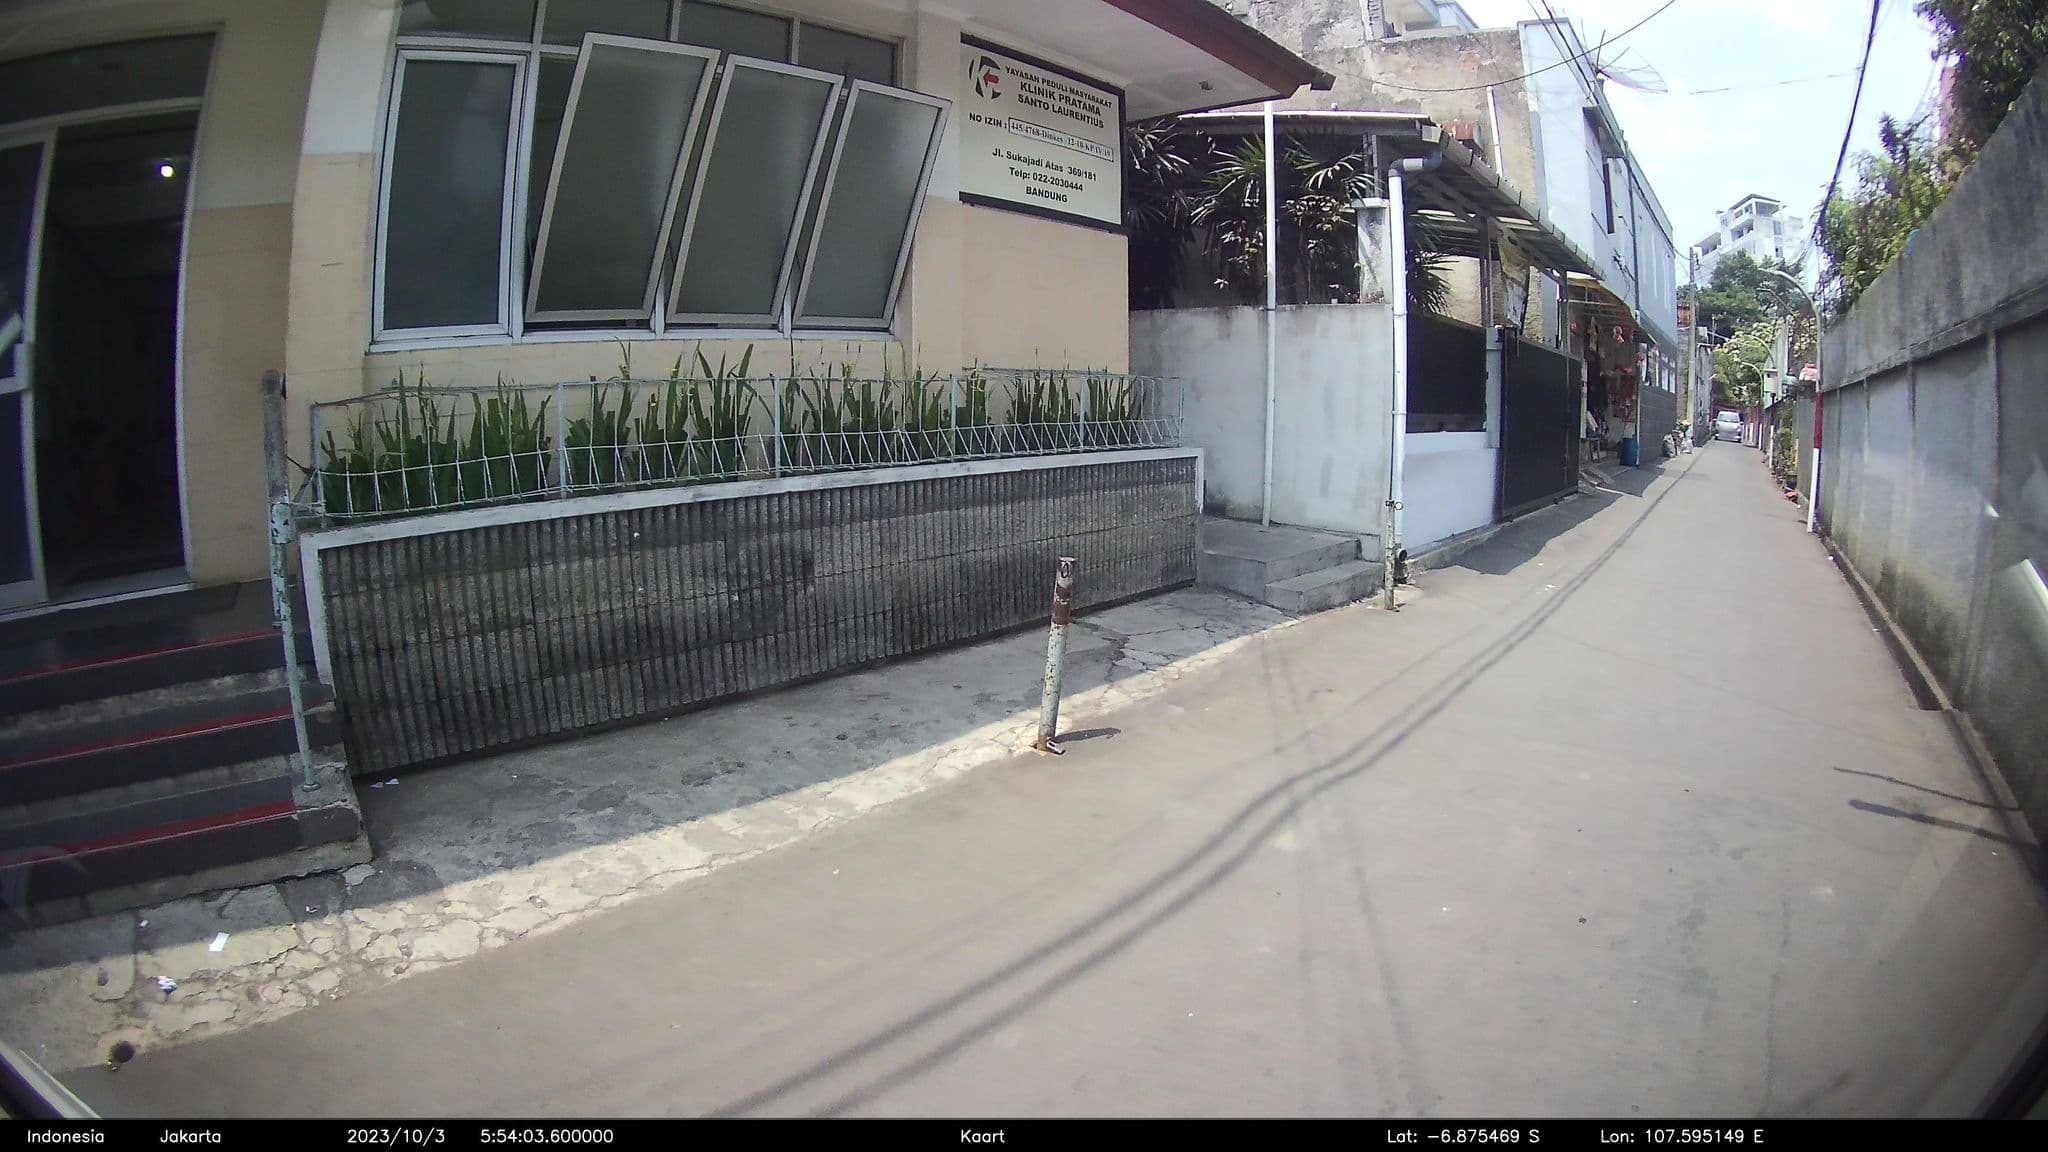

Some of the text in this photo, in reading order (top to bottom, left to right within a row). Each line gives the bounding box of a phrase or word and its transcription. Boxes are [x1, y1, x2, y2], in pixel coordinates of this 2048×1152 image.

[1005, 66, 1112, 109] YAYASAN PEDULI MASYARAKAT
[1020, 81, 1101, 116] KLINIK PRATAMA
[969, 112, 982, 123] NO
[984, 116, 1002, 127] IZIN
[1018, 94, 1104, 129] SANTO LAURENTIUS
[992, 148, 1097, 181] Jl. Sukajadi Atas 369/181
[1009, 166, 1083, 192] Telp: 022-2030444
[1025, 185, 1068, 203] BANDUNG
